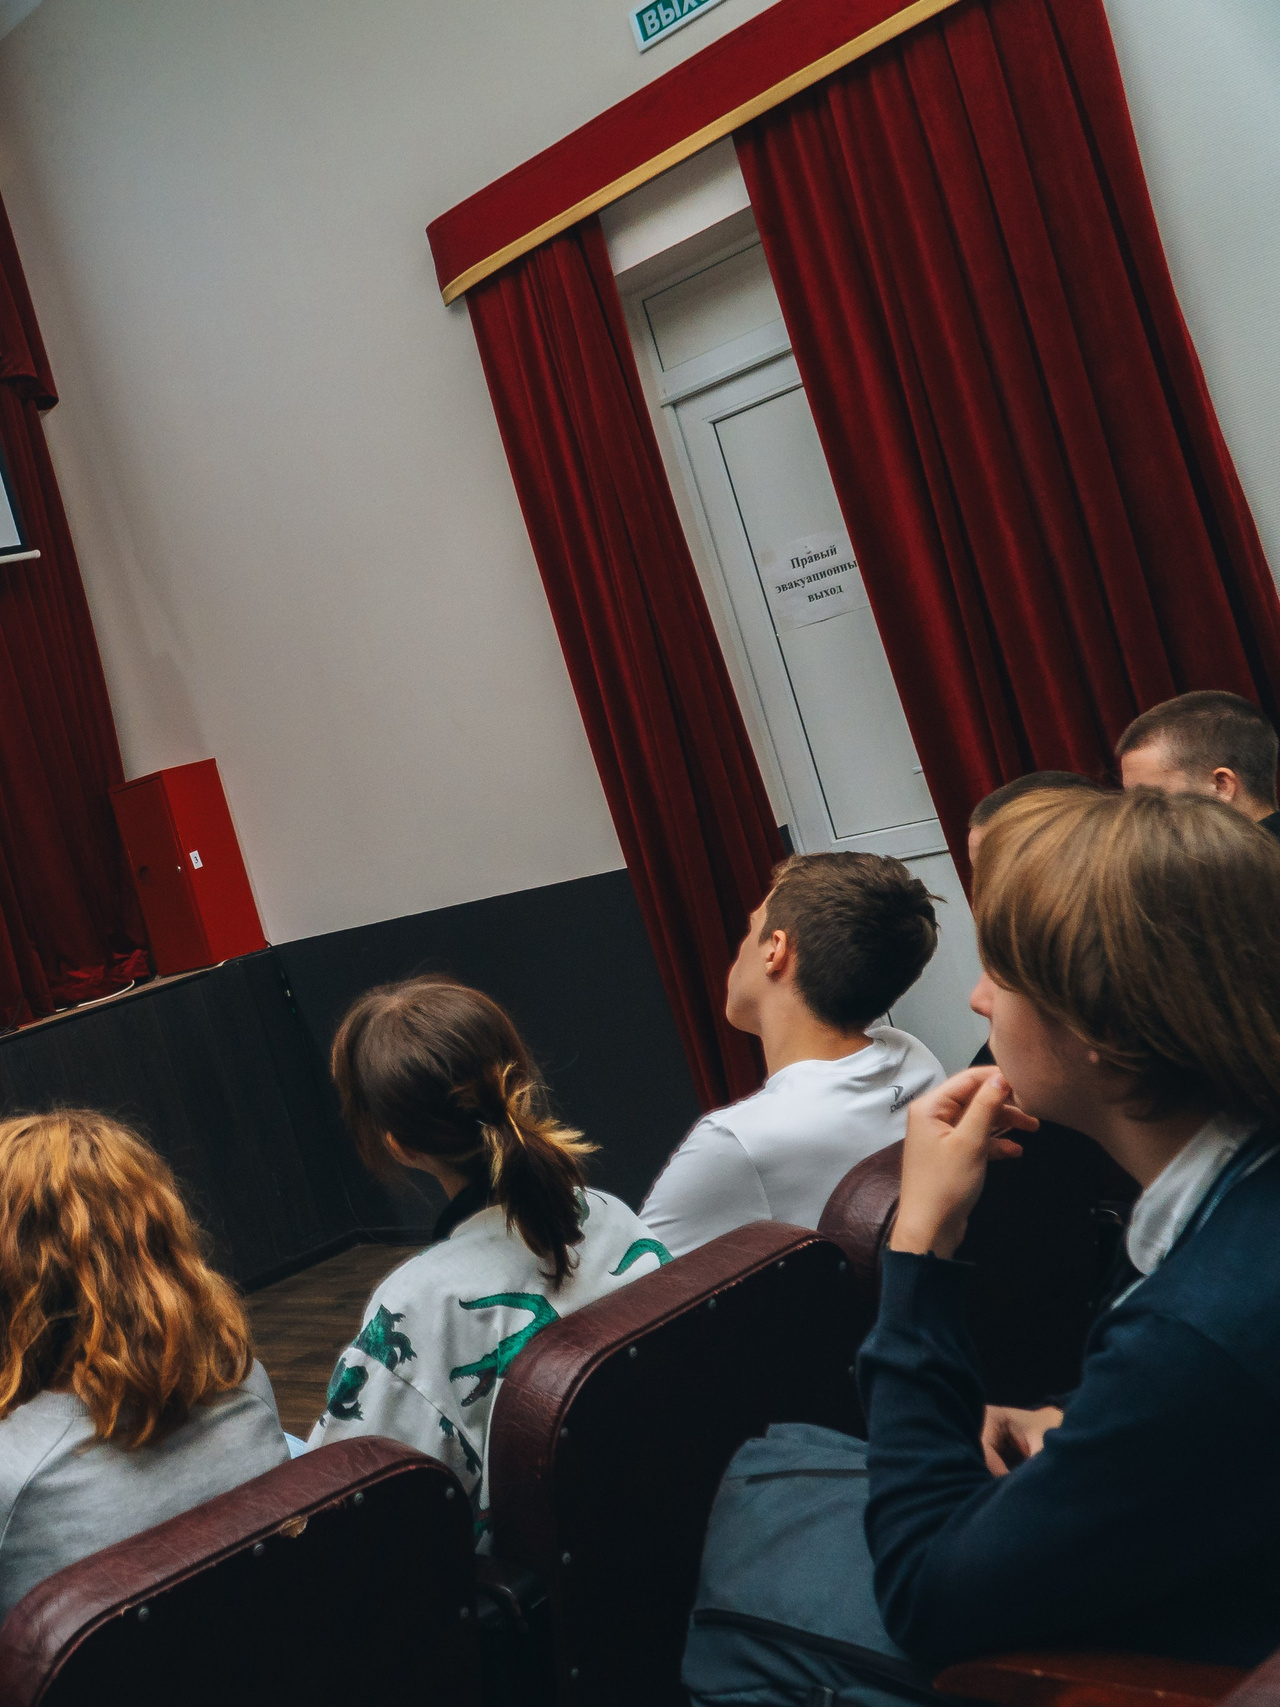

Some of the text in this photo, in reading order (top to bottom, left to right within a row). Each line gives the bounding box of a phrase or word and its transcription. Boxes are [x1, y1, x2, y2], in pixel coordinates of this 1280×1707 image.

[642, 0, 706, 37] ВЫХ
[790, 545, 837, 569] Правый
[775, 560, 858, 594] эвакуационны
[807, 585, 844, 603] выход
